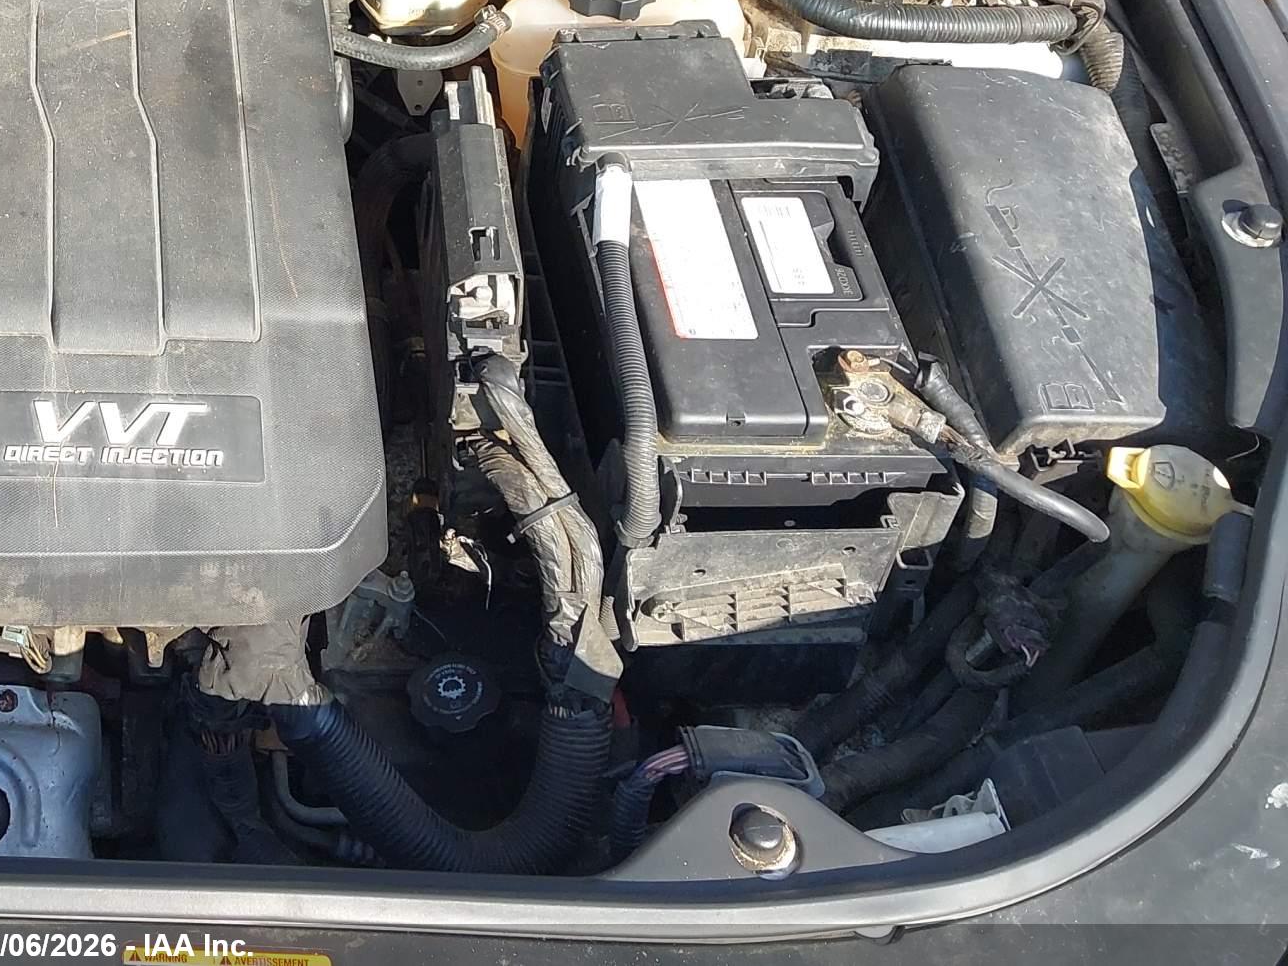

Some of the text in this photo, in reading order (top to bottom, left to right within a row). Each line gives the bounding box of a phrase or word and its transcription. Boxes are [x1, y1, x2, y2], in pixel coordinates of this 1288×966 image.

[32, 398, 211, 447] VVT
[3, 444, 224, 467] DIRECT INJECTION
[144, 953, 188, 963] WARNING
[234, 956, 309, 966] AVERTISSEMENT
